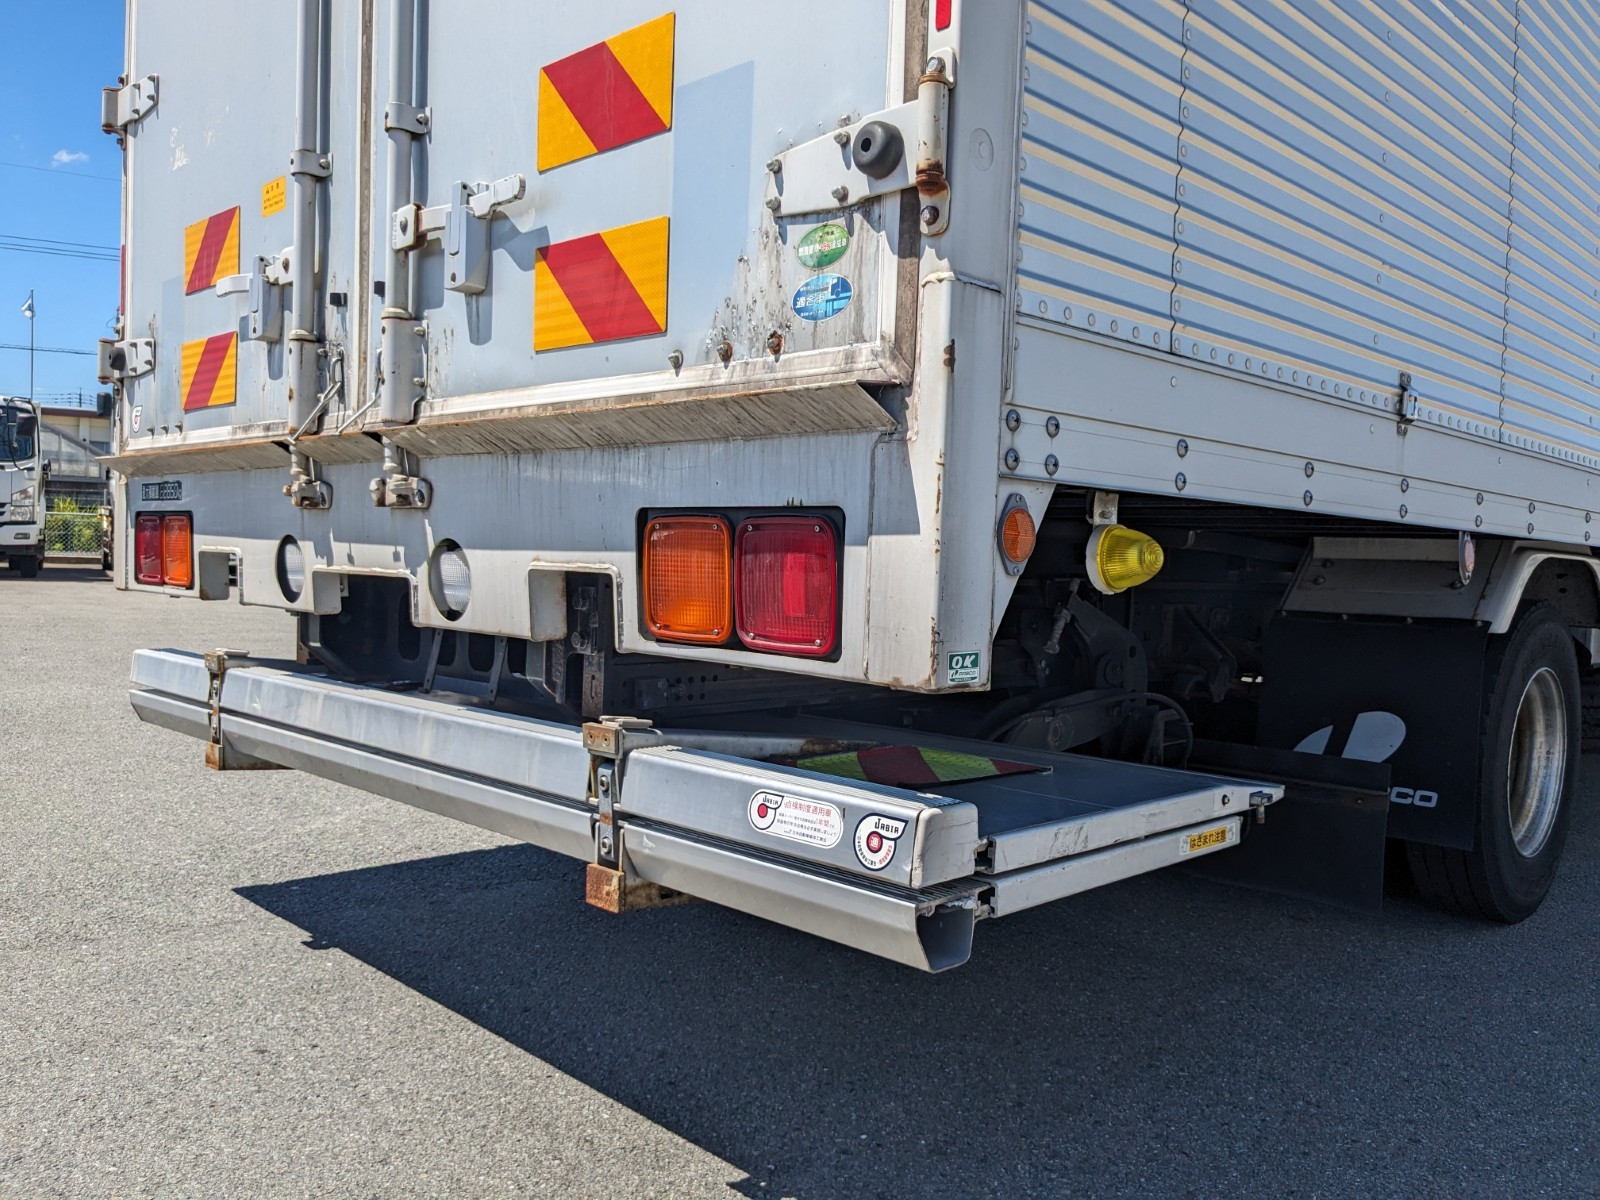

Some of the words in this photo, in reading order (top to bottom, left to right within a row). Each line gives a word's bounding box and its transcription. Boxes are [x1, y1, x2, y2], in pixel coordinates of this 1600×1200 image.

[796, 293, 825, 308] 適合車
[952, 655, 976, 669] OK
[874, 818, 899, 834] JABIA
